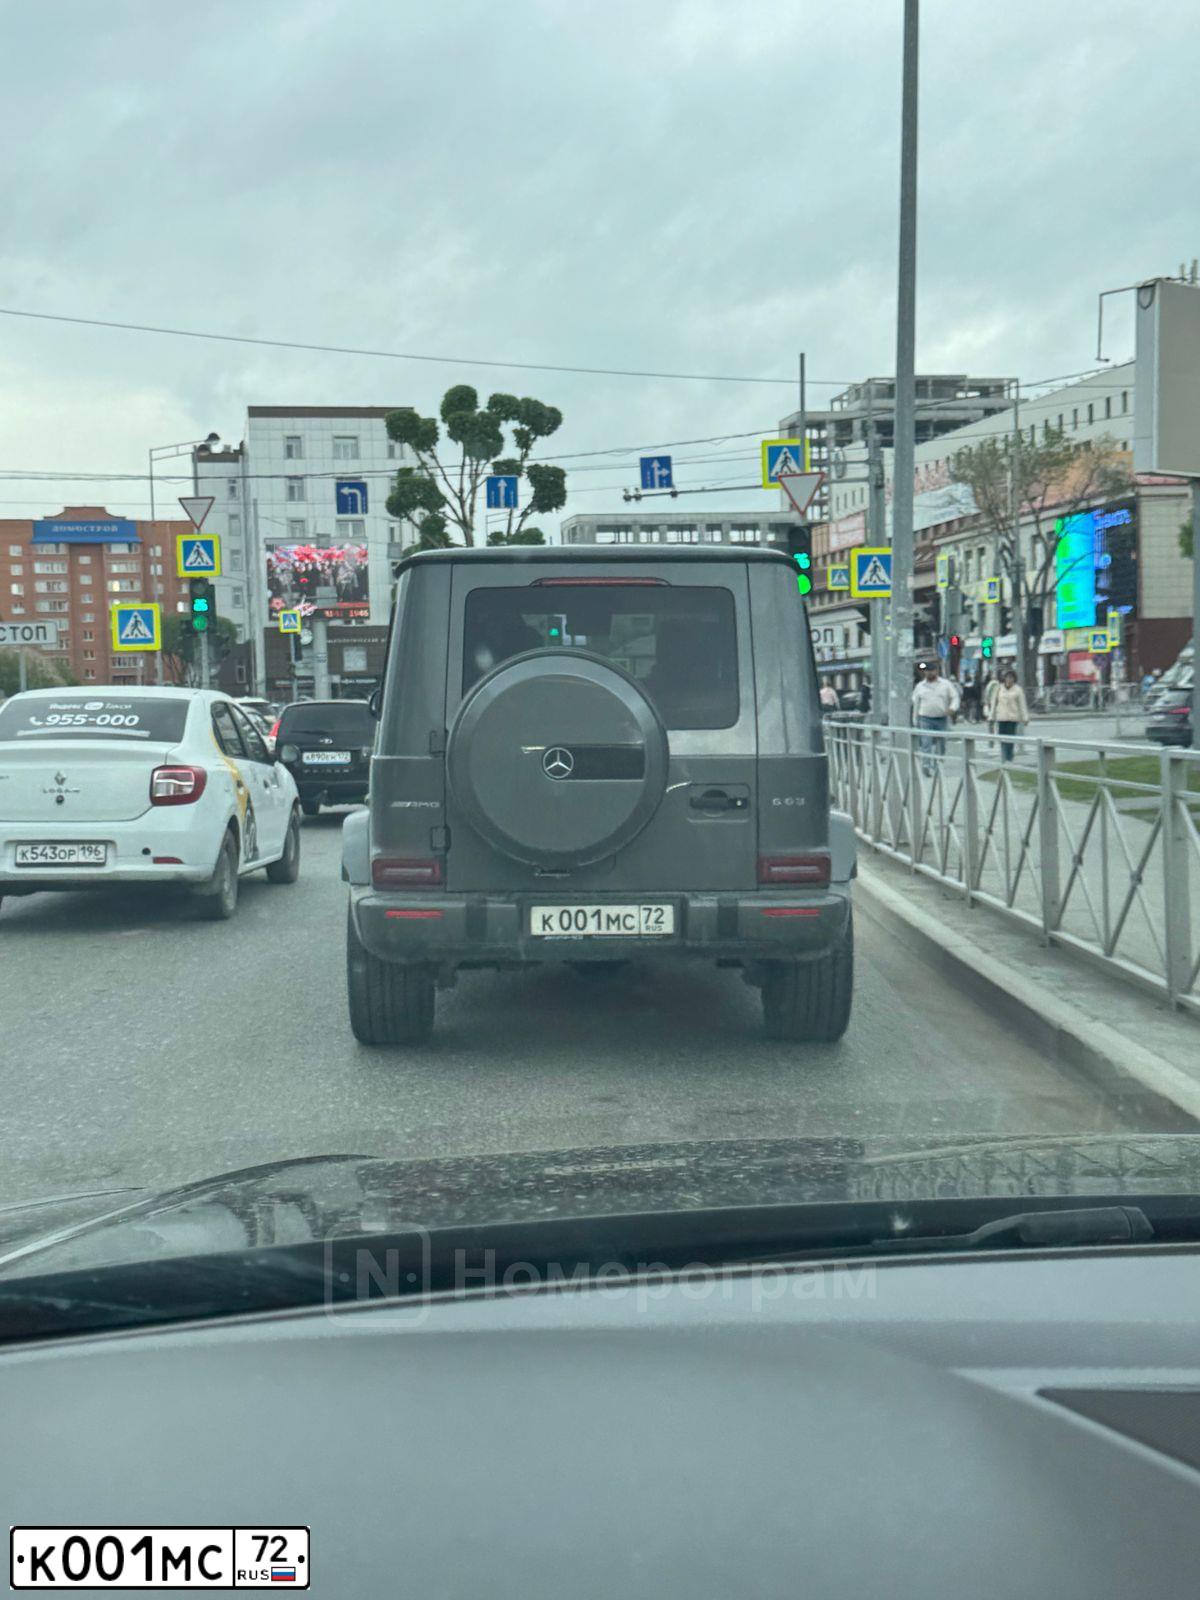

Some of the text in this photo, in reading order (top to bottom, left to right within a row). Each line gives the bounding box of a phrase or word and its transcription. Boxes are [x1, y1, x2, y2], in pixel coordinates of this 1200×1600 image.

[811, 628, 833, 644] ОП
[45, 714, 139, 726] 955-000
[20, 845, 102, 861] К543ОР 196
[541, 907, 665, 931] К001МС 72
